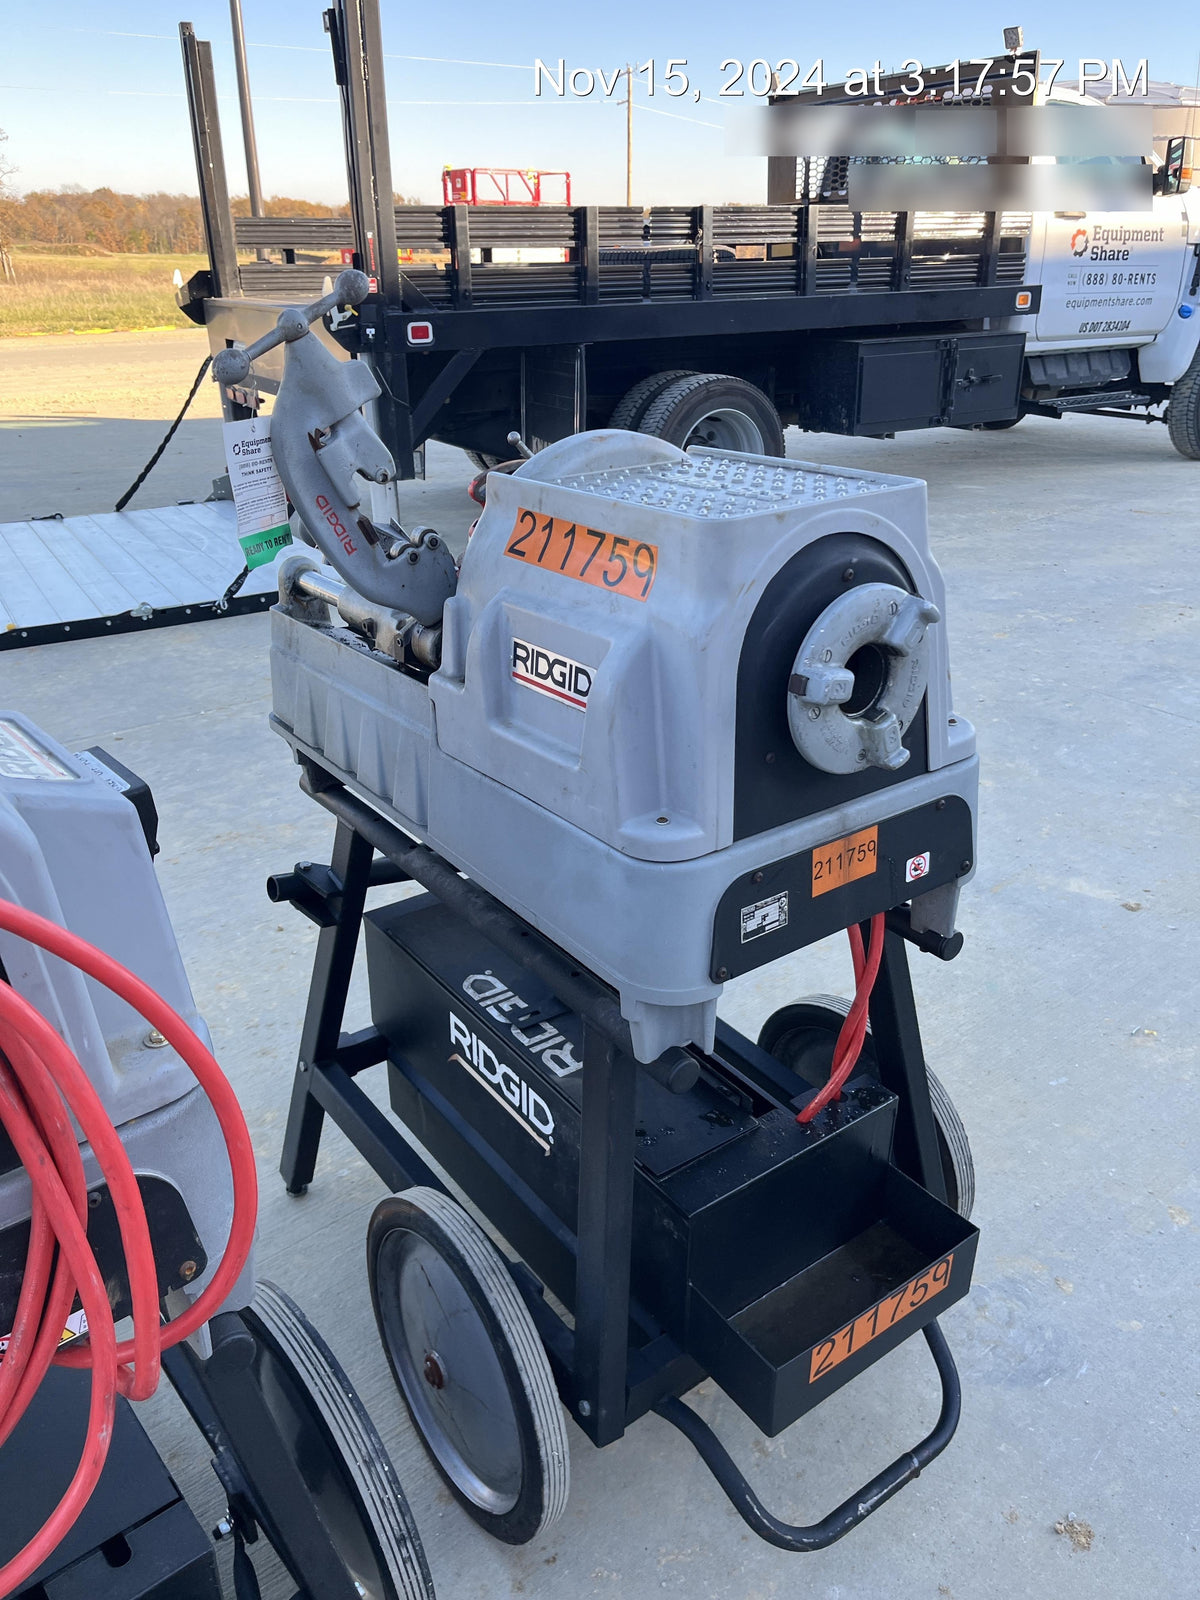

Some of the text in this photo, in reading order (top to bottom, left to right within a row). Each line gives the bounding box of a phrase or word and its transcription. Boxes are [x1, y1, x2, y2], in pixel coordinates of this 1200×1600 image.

[1093, 225, 1164, 245] Equipment
[1090, 246, 1130, 261] Share
[1082, 272, 1157, 286] (888) 80-RENTS
[1065, 295, 1153, 310] equipmentshare.com
[1078, 321, 1089, 333] US
[1088, 321, 1102, 333] DOT
[241, 436, 272, 449] Equipmen
[241, 447, 261, 456] Share
[255, 466, 272, 475] SAFETY
[315, 494, 358, 557] RIDGID
[245, 533, 291, 557] READY TO RENT
[507, 510, 655, 598] 211759
[512, 640, 592, 698] RIDGID
[813, 839, 877, 881] 211759
[450, 1011, 555, 1142] RIDGID
[812, 1258, 951, 1379] 211759
